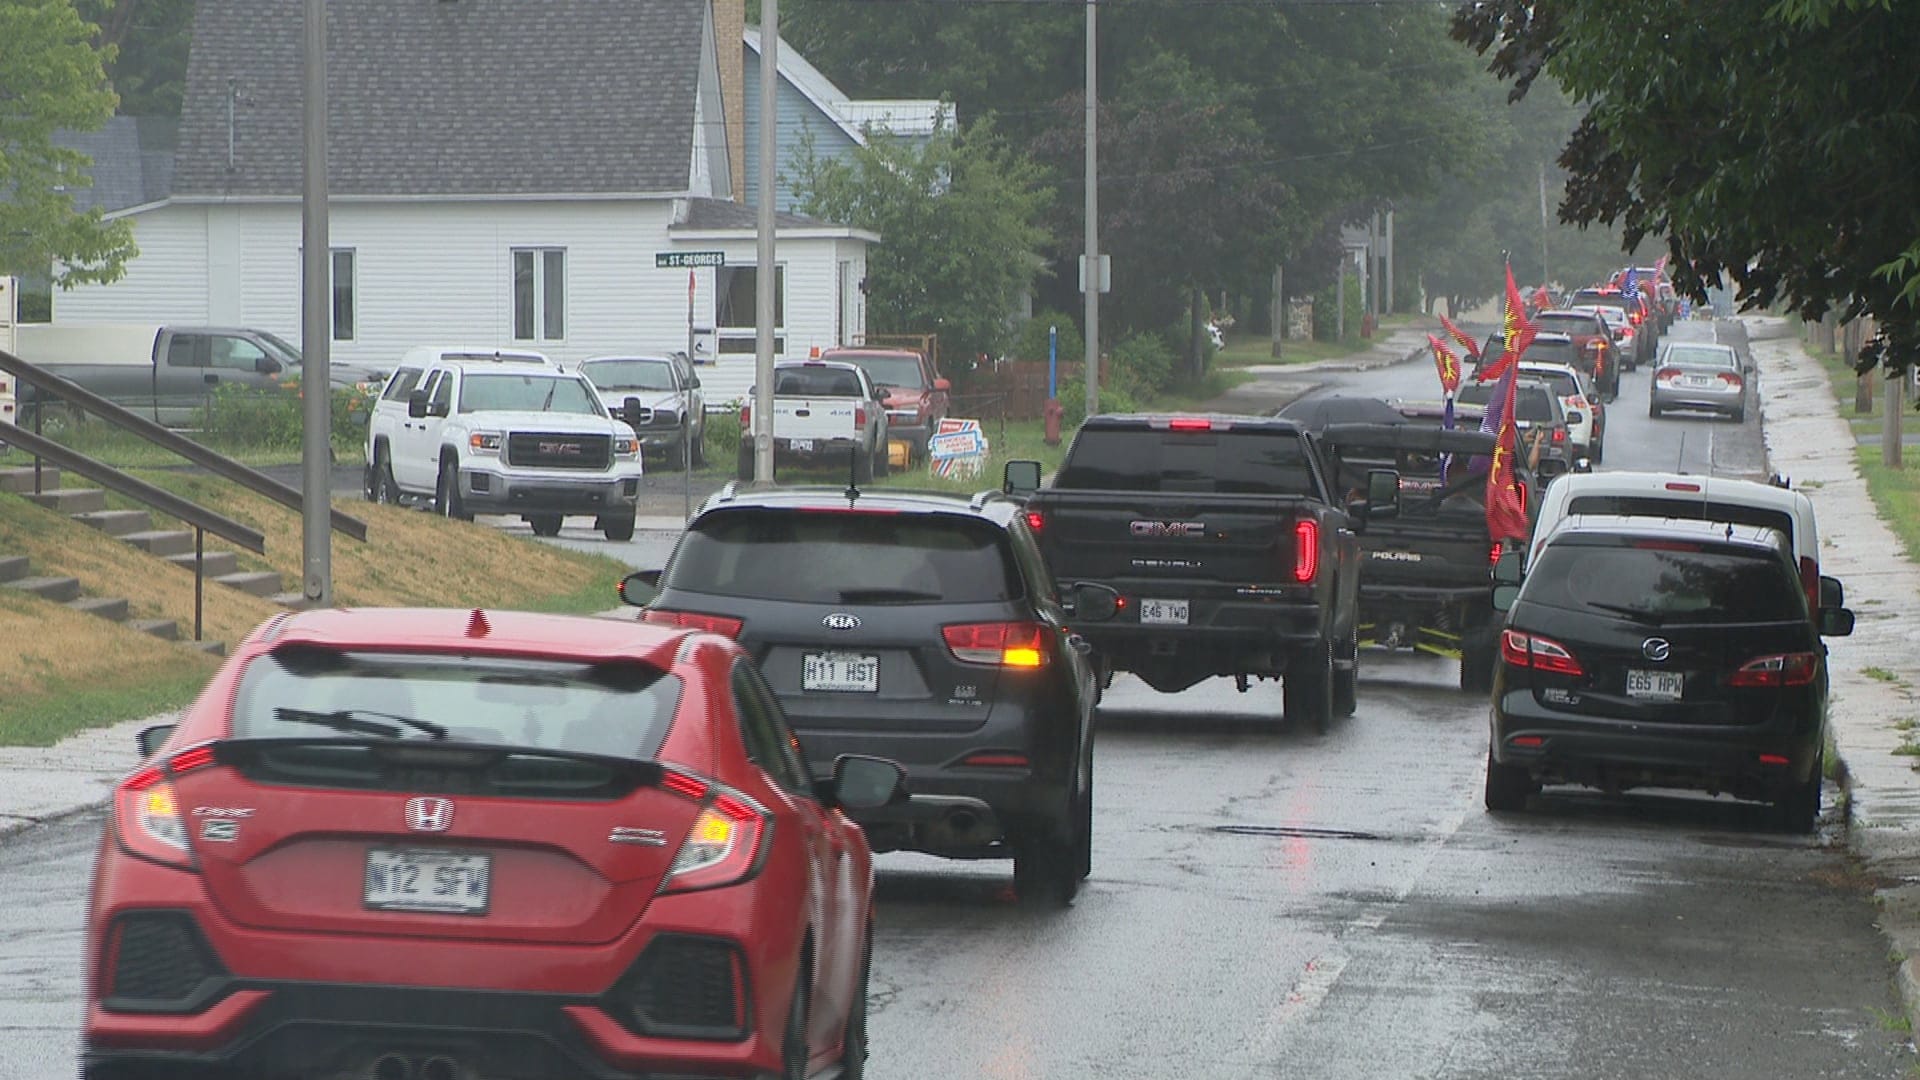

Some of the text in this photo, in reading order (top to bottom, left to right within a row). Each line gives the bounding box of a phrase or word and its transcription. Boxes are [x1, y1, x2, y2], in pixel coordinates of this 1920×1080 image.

[669, 254, 723, 266] ST-GEORGES
[1130, 520, 1205, 536] GMC
[1372, 551, 1421, 562] POLARIS
[828, 616, 855, 628] KIA
[805, 661, 876, 682] H11 HST
[1628, 674, 1682, 693] E65 HPW
[368, 863, 485, 898] N12 SFW
